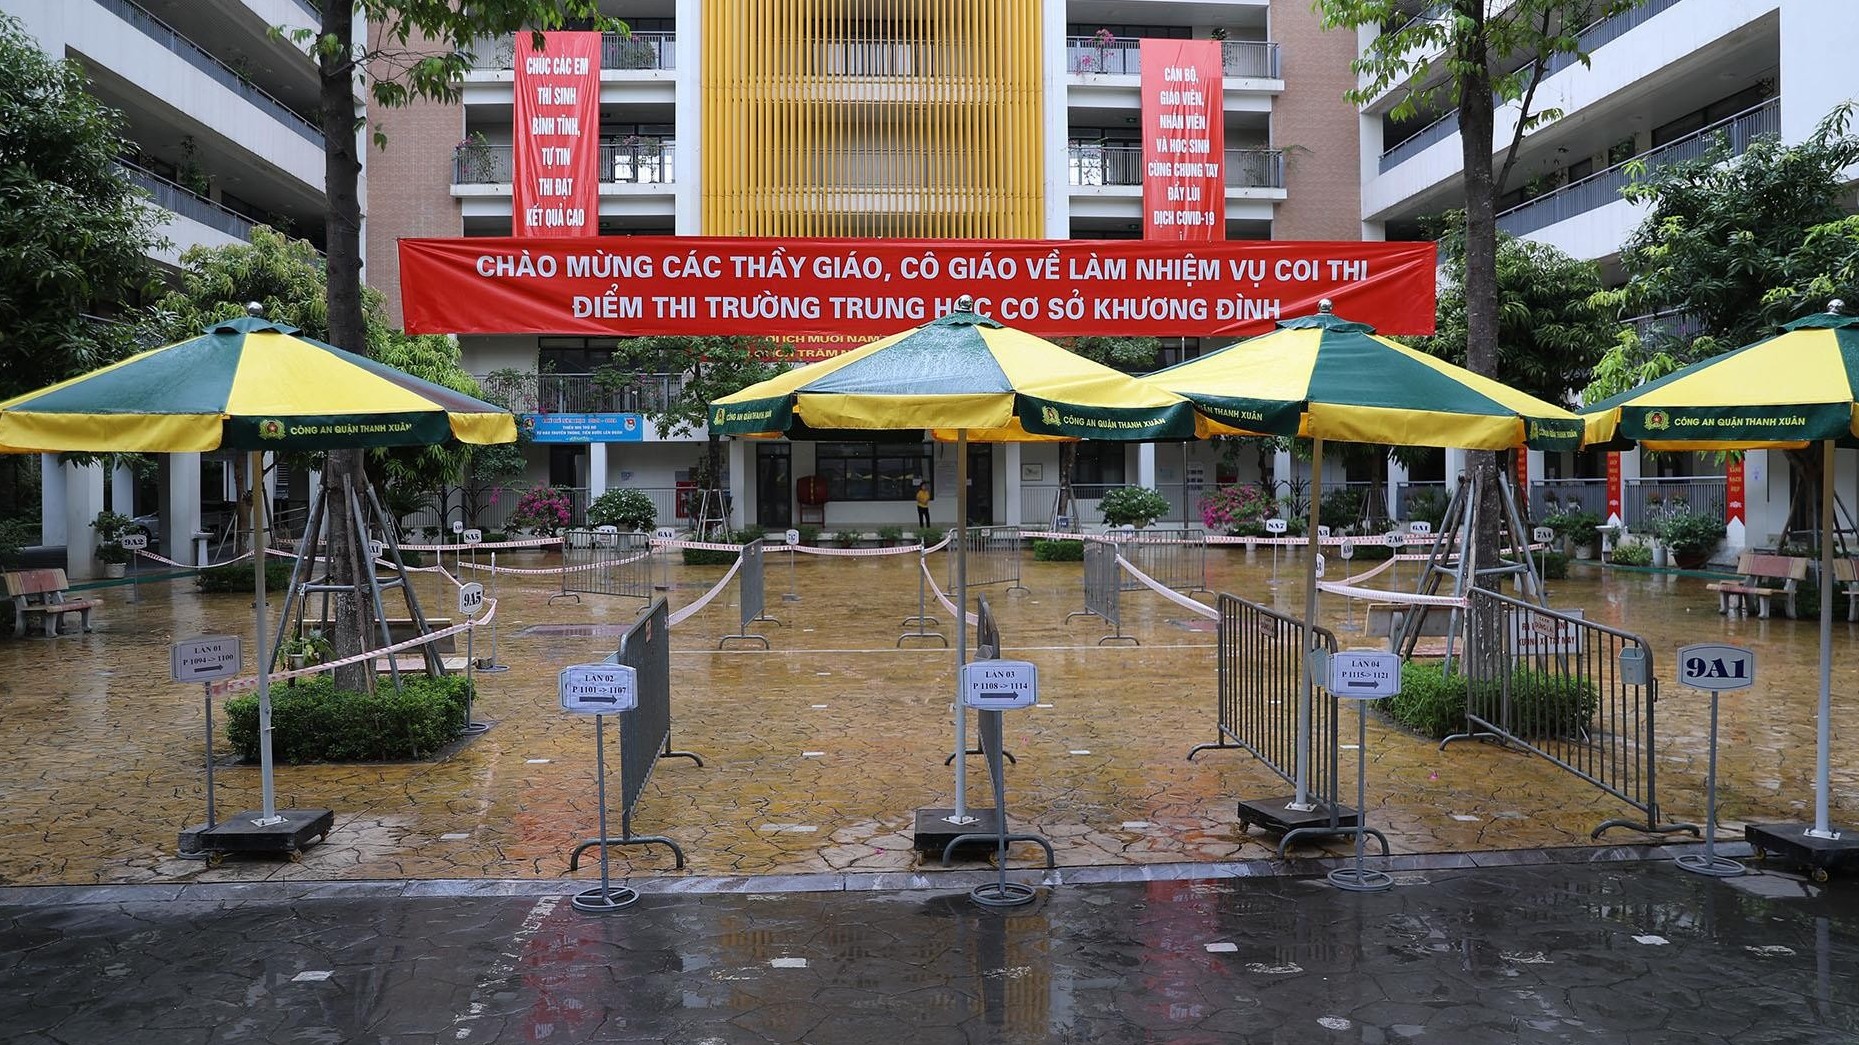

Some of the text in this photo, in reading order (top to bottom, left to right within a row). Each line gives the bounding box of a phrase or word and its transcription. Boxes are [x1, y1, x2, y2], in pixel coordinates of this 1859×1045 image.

[526, 54, 588, 75] CHÚC CÁC EM
[1164, 65, 1198, 84] CÁN BỘ,
[538, 84, 576, 105] THÍ SINH
[1160, 88, 1204, 107] GIÁO VIÊN,
[532, 114, 554, 135] BÌNH
[1186, 112, 1206, 129] VIÊN
[1156, 137, 1210, 156] VÀ HỌC SINH
[542, 147, 570, 169] TỰ TIN
[1148, 160, 1218, 178] CÙNG CHUNG TAY
[539, 178, 573, 199] THI ĐẠT
[1168, 181, 1200, 202] ĐẨY LÙI
[526, 203, 584, 227] KẾT QUẢ CAO
[1154, 210, 1214, 230] DỊCH COVID-19
[476, 246, 1368, 288] CHÀO MỪNG CÁC THẦY GIÁO, CÔ GIÁO VỀ LÀM NHIỆM VỤ COI THI
[572, 282, 1281, 320] ĐIỂM THI TRƯỜNG TRUNG HC CƠ SỞ KHƯƠNG ĐÌNH
[1064, 414, 1085, 426] CÔNG
[1086, 418, 1096, 427] AN
[1098, 418, 1116, 430] QUẬN
[1144, 417, 1166, 427] XUÂN
[1214, 408, 1240, 418] THANH
[1241, 410, 1262, 421] XUÂN
[1674, 415, 1806, 428] CÔNG AN QUẬN THANH XUÂN
[290, 426, 318, 435] CÔNG
[320, 426, 332, 434] AN
[334, 424, 358, 436] QUẬN
[360, 424, 386, 433] THANH
[124, 538, 144, 546] 9A2
[1388, 536, 1404, 544] 7A6
[464, 592, 481, 608] 9A5
[190, 657, 207, 665] 1094
[218, 654, 234, 662] 1100
[1372, 660, 1380, 668] 04
[1686, 657, 1748, 678] 9A1
[605, 674, 614, 682] 02
[974, 682, 978, 690] P
[981, 682, 998, 690] 1108
[1011, 682, 1028, 690] 1114
[580, 686, 596, 694] 1101
